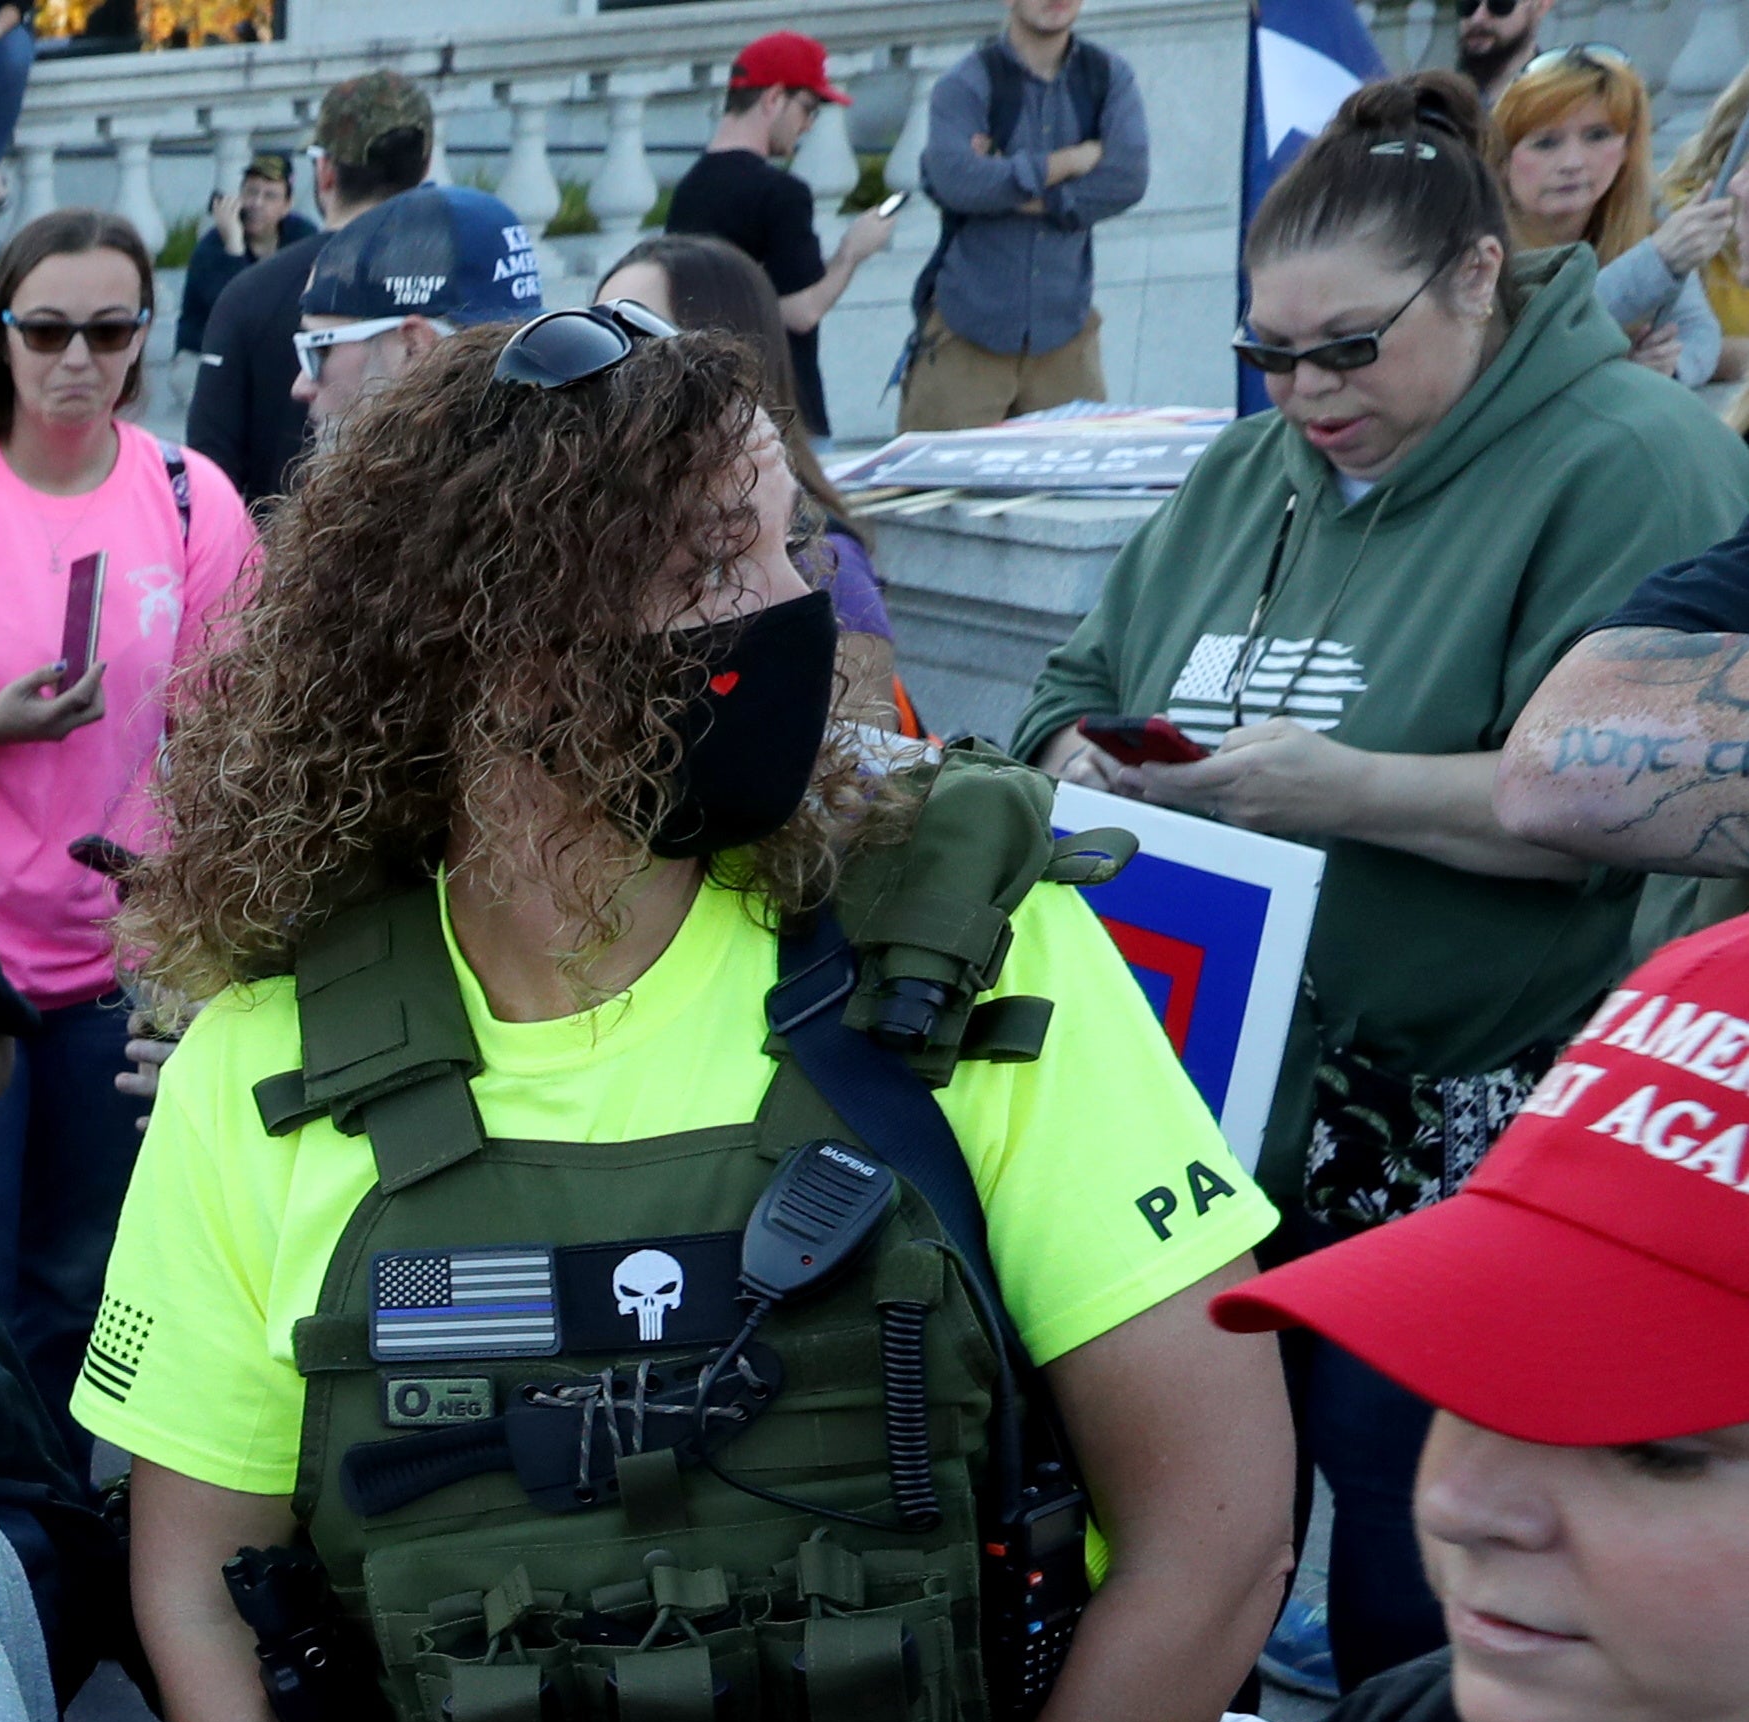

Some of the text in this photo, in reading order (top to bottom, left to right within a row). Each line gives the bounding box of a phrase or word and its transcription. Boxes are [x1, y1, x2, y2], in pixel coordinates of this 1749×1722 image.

[383, 276, 447, 292] TRUMP
[393, 290, 433, 305] 2020
[1134, 1159, 1237, 1242] PA
[394, 1383, 483, 1417] O NEG
